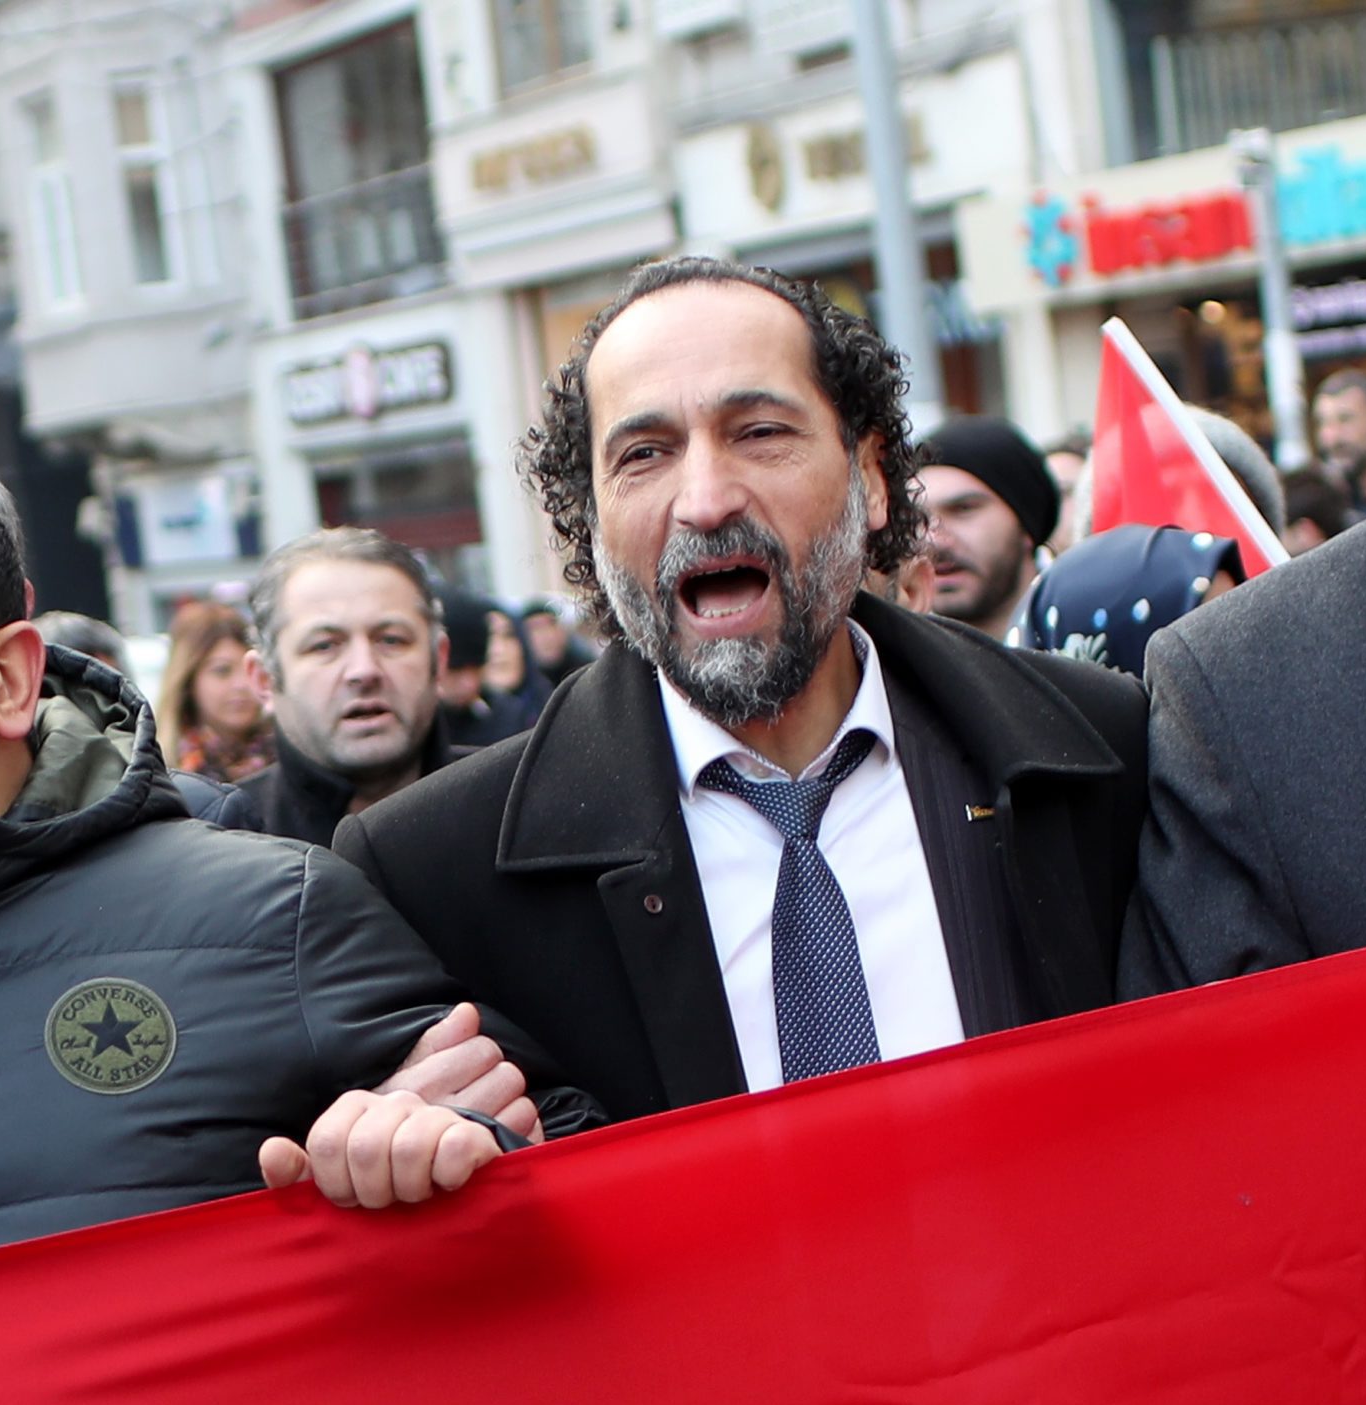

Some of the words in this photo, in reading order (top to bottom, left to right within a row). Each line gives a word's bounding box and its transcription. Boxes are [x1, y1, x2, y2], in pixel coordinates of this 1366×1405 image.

[62, 987, 158, 1021] CONVERSE
[70, 1056, 104, 1080] ALL
[110, 1055, 155, 1080] STAR
